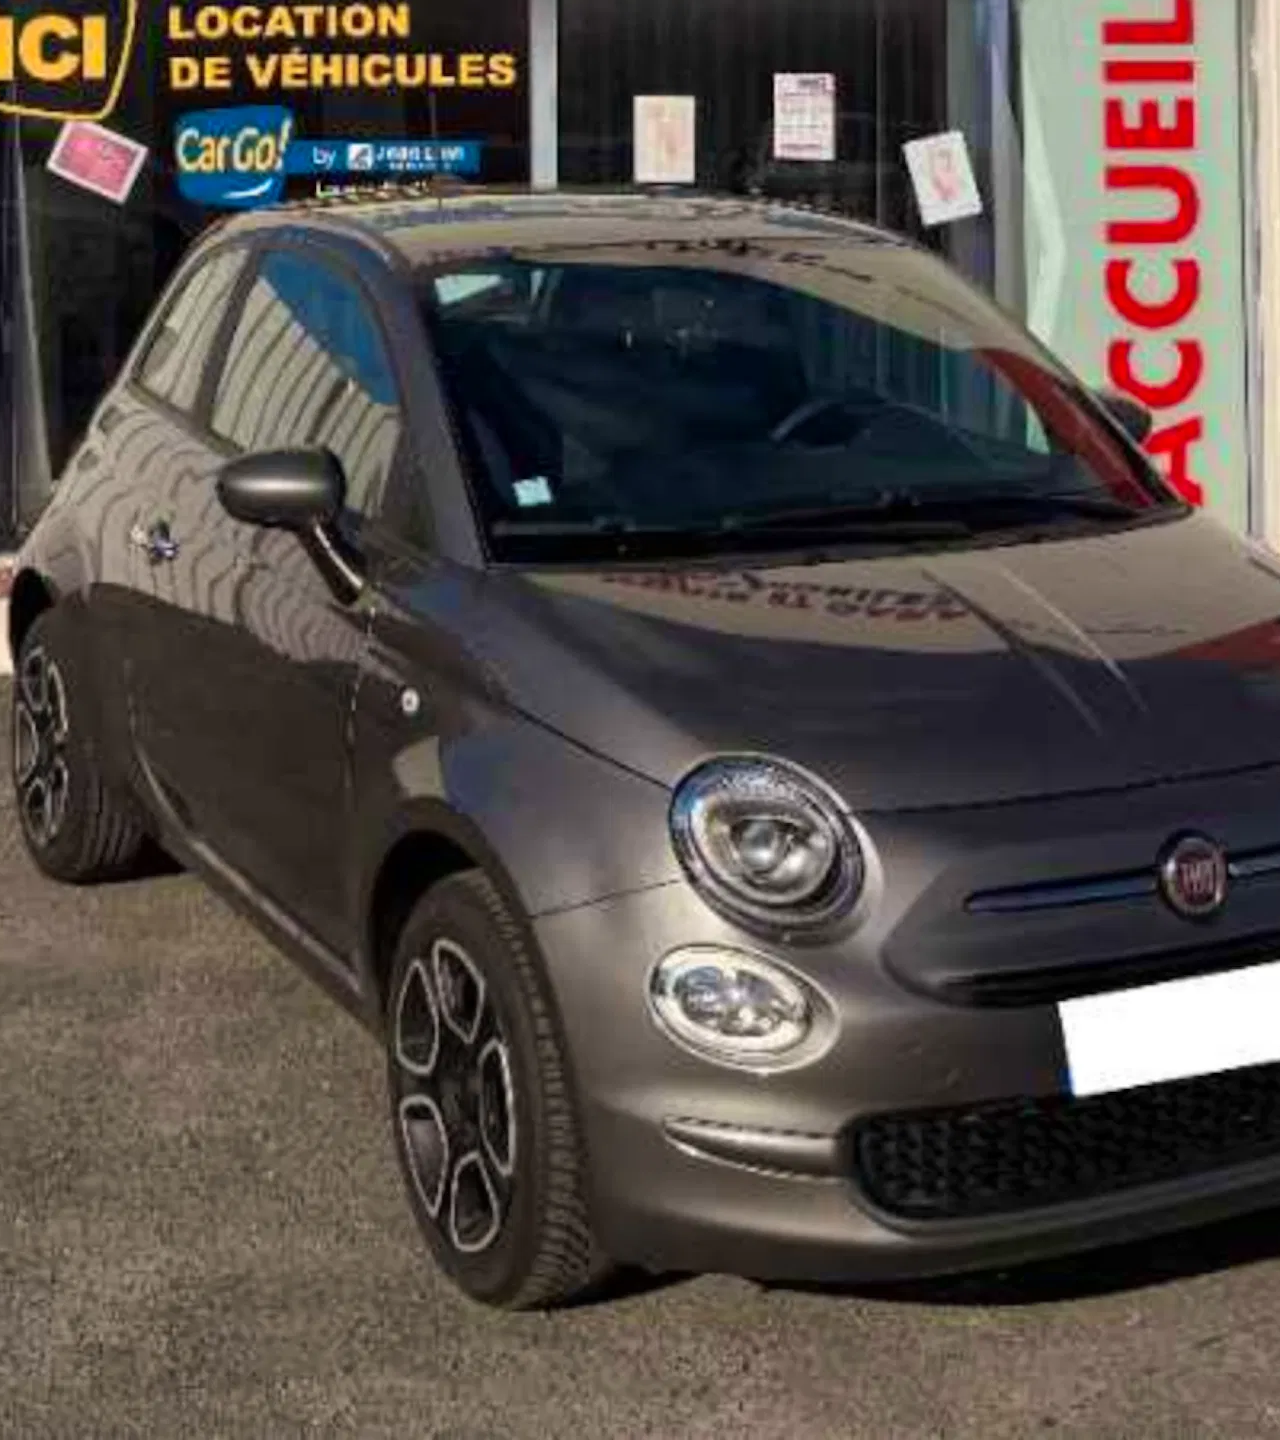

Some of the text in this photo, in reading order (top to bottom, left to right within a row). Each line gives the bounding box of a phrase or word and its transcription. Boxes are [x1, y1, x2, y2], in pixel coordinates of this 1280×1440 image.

[168, 3, 411, 40] LOCATION
[169, 46, 517, 90] DE VÉHICULES
[312, 145, 337, 171] by
